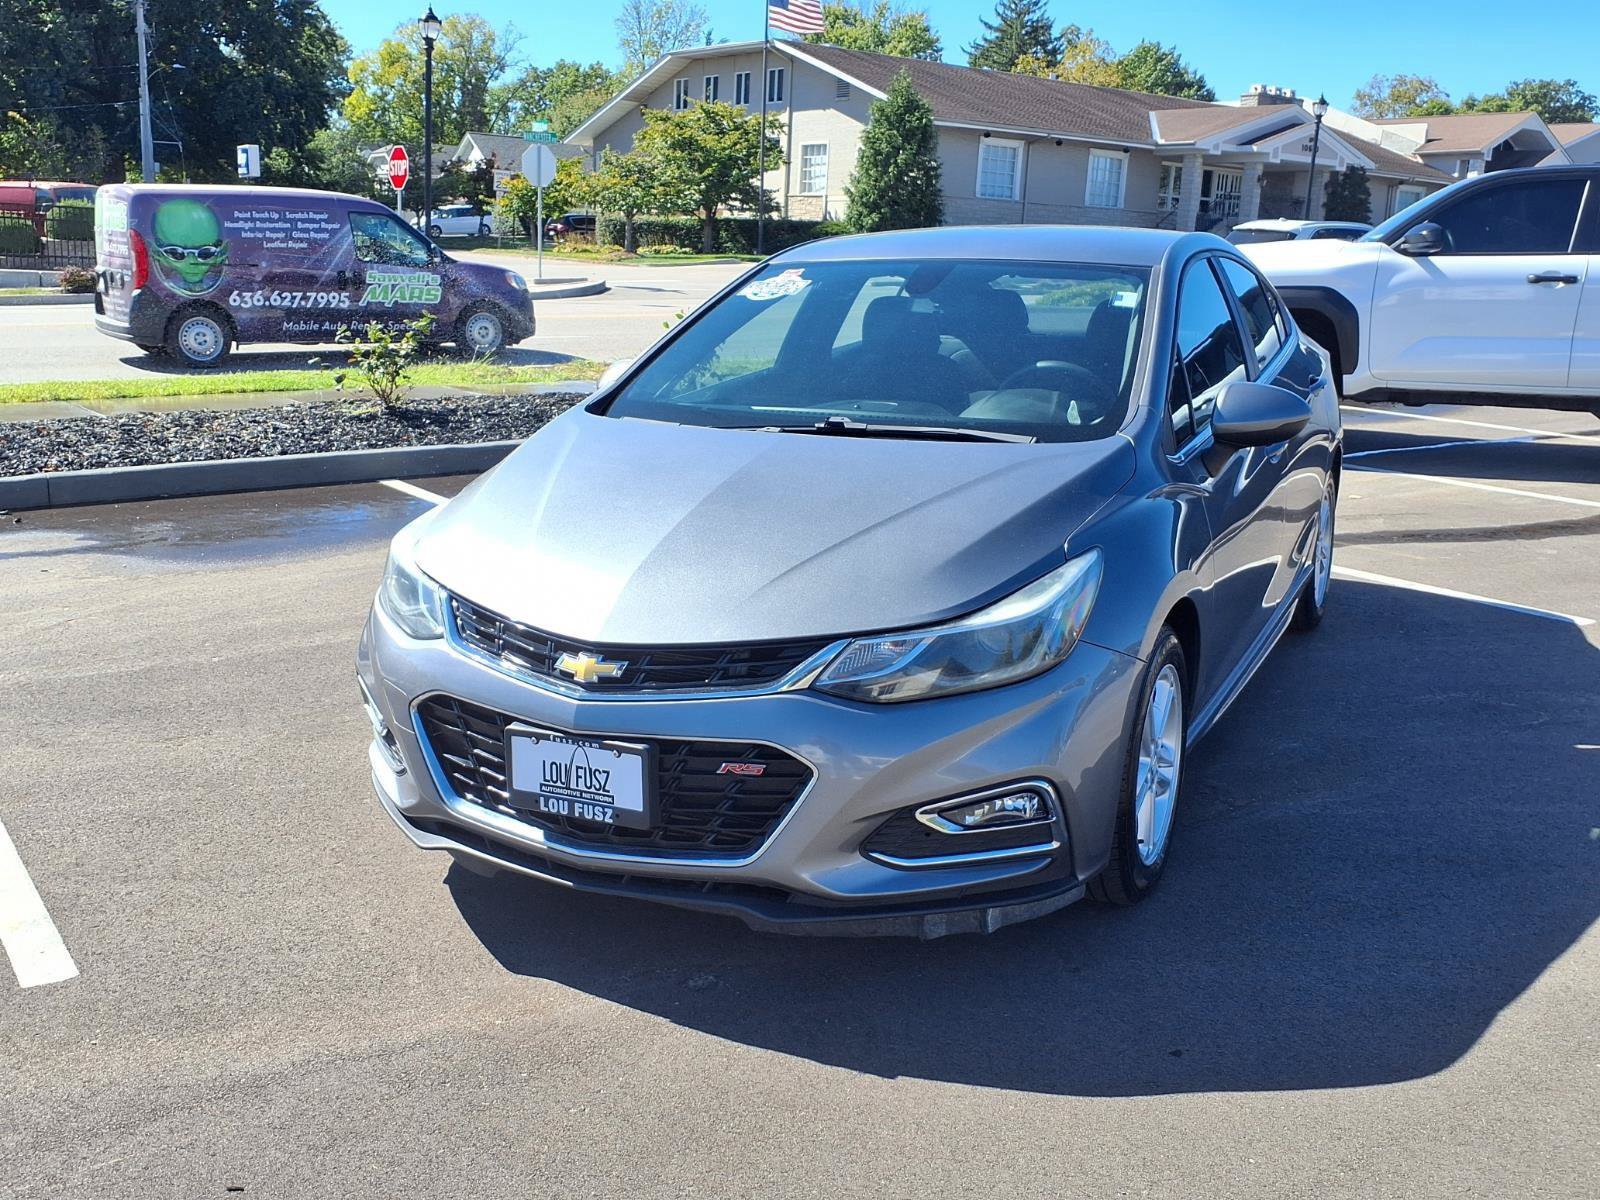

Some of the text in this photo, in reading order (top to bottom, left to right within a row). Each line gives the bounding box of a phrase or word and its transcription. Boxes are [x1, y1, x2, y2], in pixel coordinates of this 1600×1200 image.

[390, 159, 407, 176] STOP
[234, 211, 251, 219] Paint
[252, 211, 269, 219] Touch
[270, 211, 280, 220] Up
[309, 212, 329, 220] Repair
[321, 222, 341, 230] Repair
[266, 231, 286, 239] Repair
[310, 231, 330, 239] Repair
[263, 240, 308, 249] Leather Repair
[229, 290, 350, 308] 636.627.7995
[359, 284, 442, 307] MARS
[282, 320, 319, 331] Mobile
[321, 321, 347, 331] Auto
[542, 759, 611, 793] LOU FUSZ
[716, 762, 767, 775] RS
[541, 785, 613, 803] AUTOMOTIVE NETWORK
[540, 797, 614, 823] LOU FUSZ
